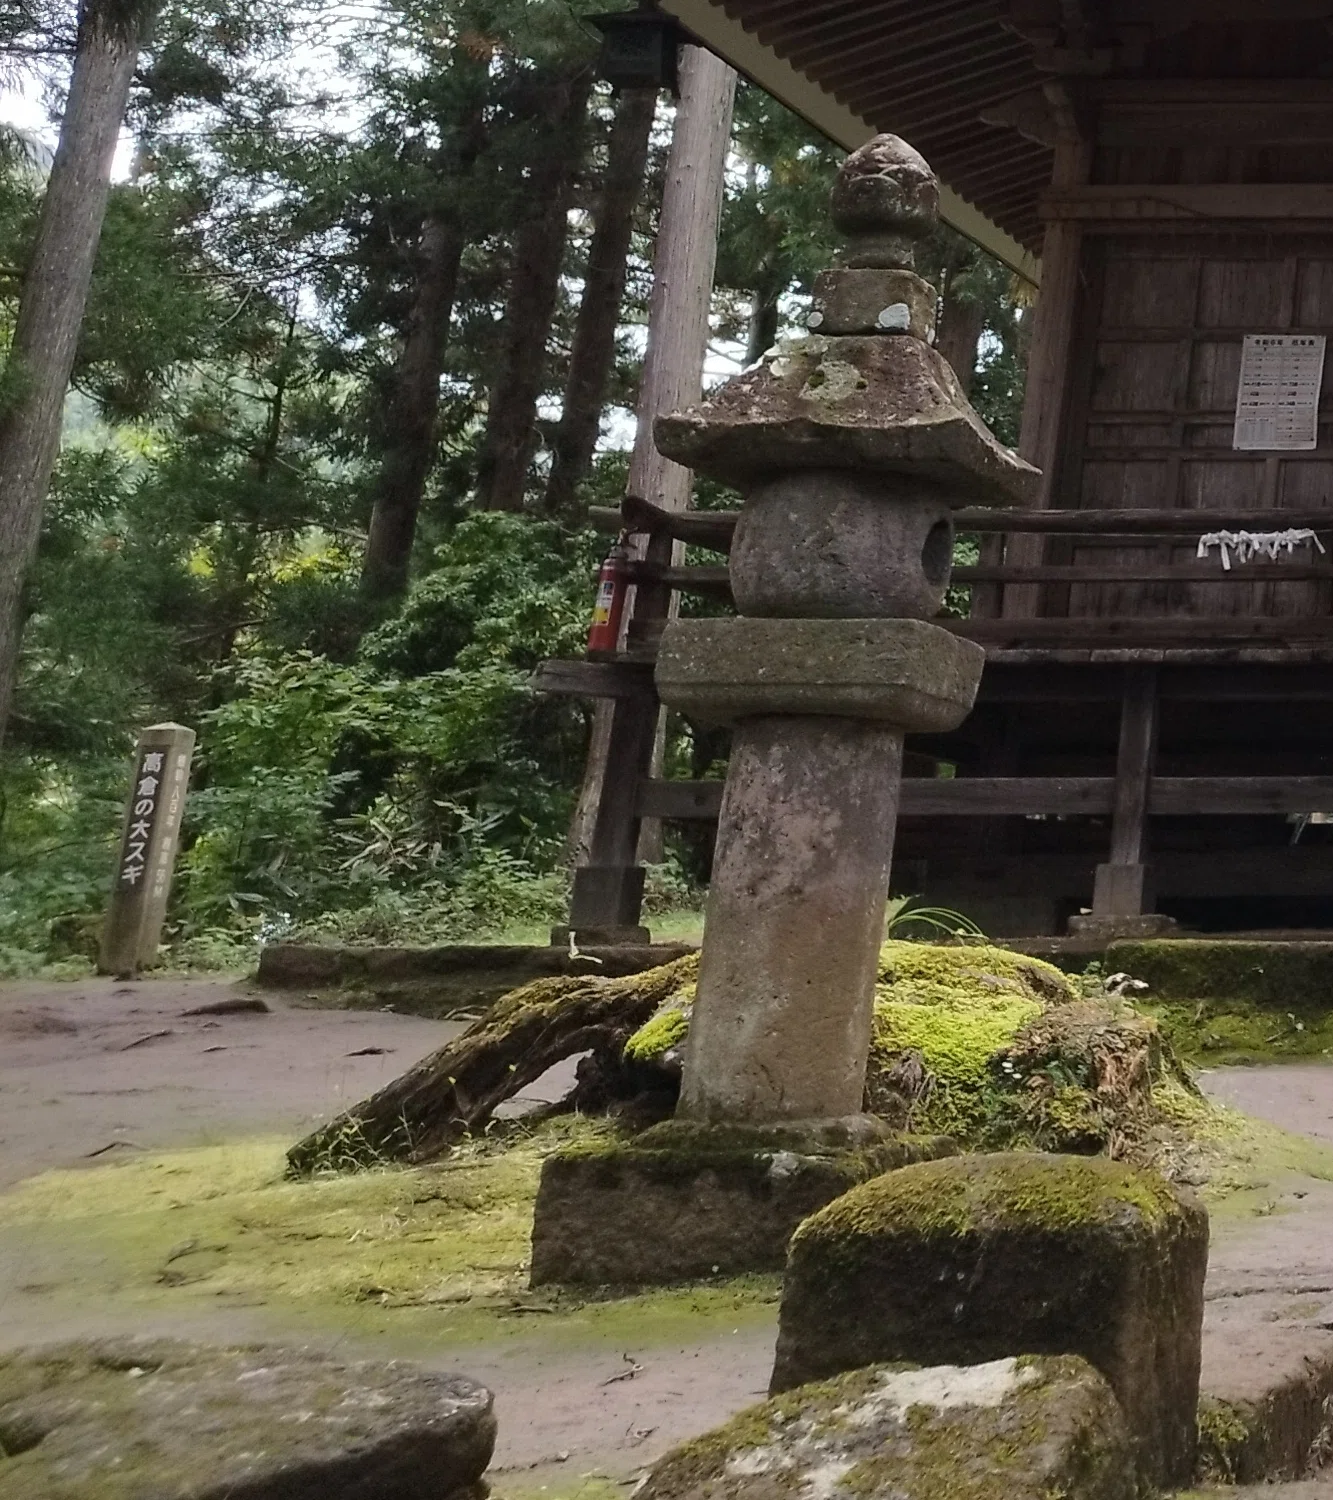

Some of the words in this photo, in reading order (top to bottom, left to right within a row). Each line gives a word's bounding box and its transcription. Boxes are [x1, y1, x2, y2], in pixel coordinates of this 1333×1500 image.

[121, 752, 164, 885] 高倉の大スギ
